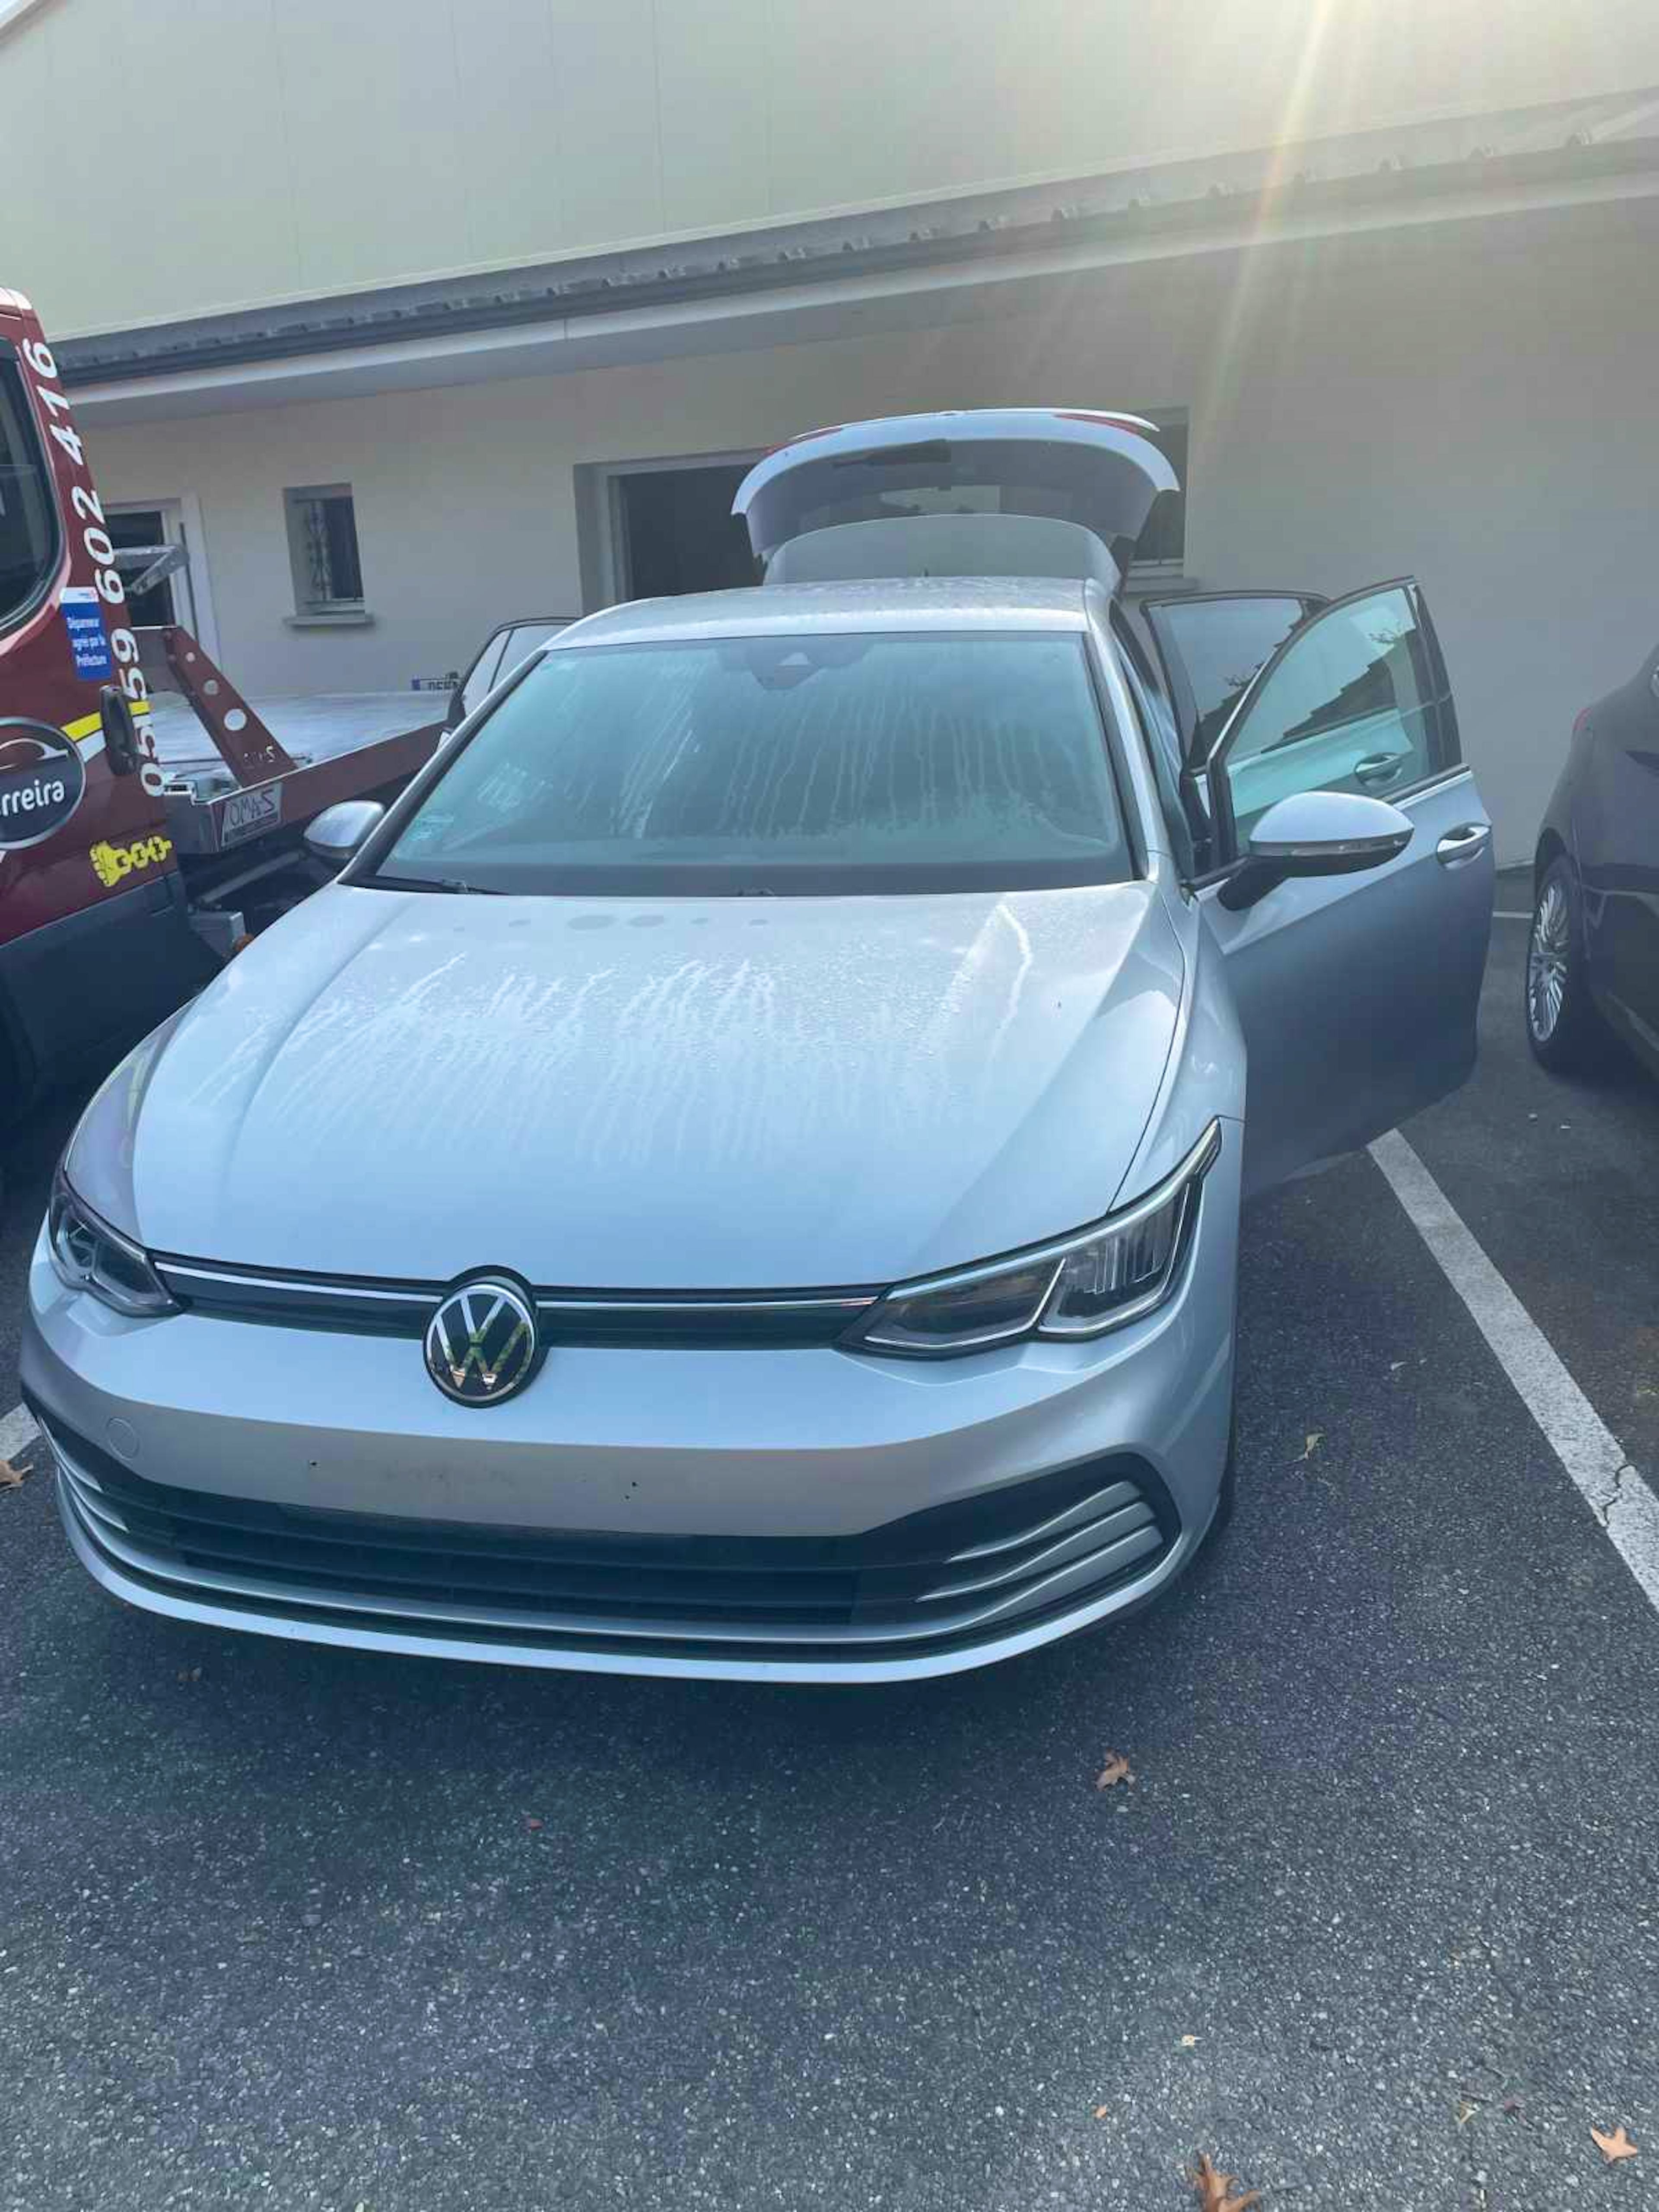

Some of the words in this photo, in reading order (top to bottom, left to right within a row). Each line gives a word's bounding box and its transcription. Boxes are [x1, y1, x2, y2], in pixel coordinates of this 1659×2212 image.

[22, 338, 83, 465] 416
[72, 486, 124, 604] 602
[111, 629, 147, 700] 59
[0, 779, 65, 812] rreira
[135, 727, 165, 796] 05
